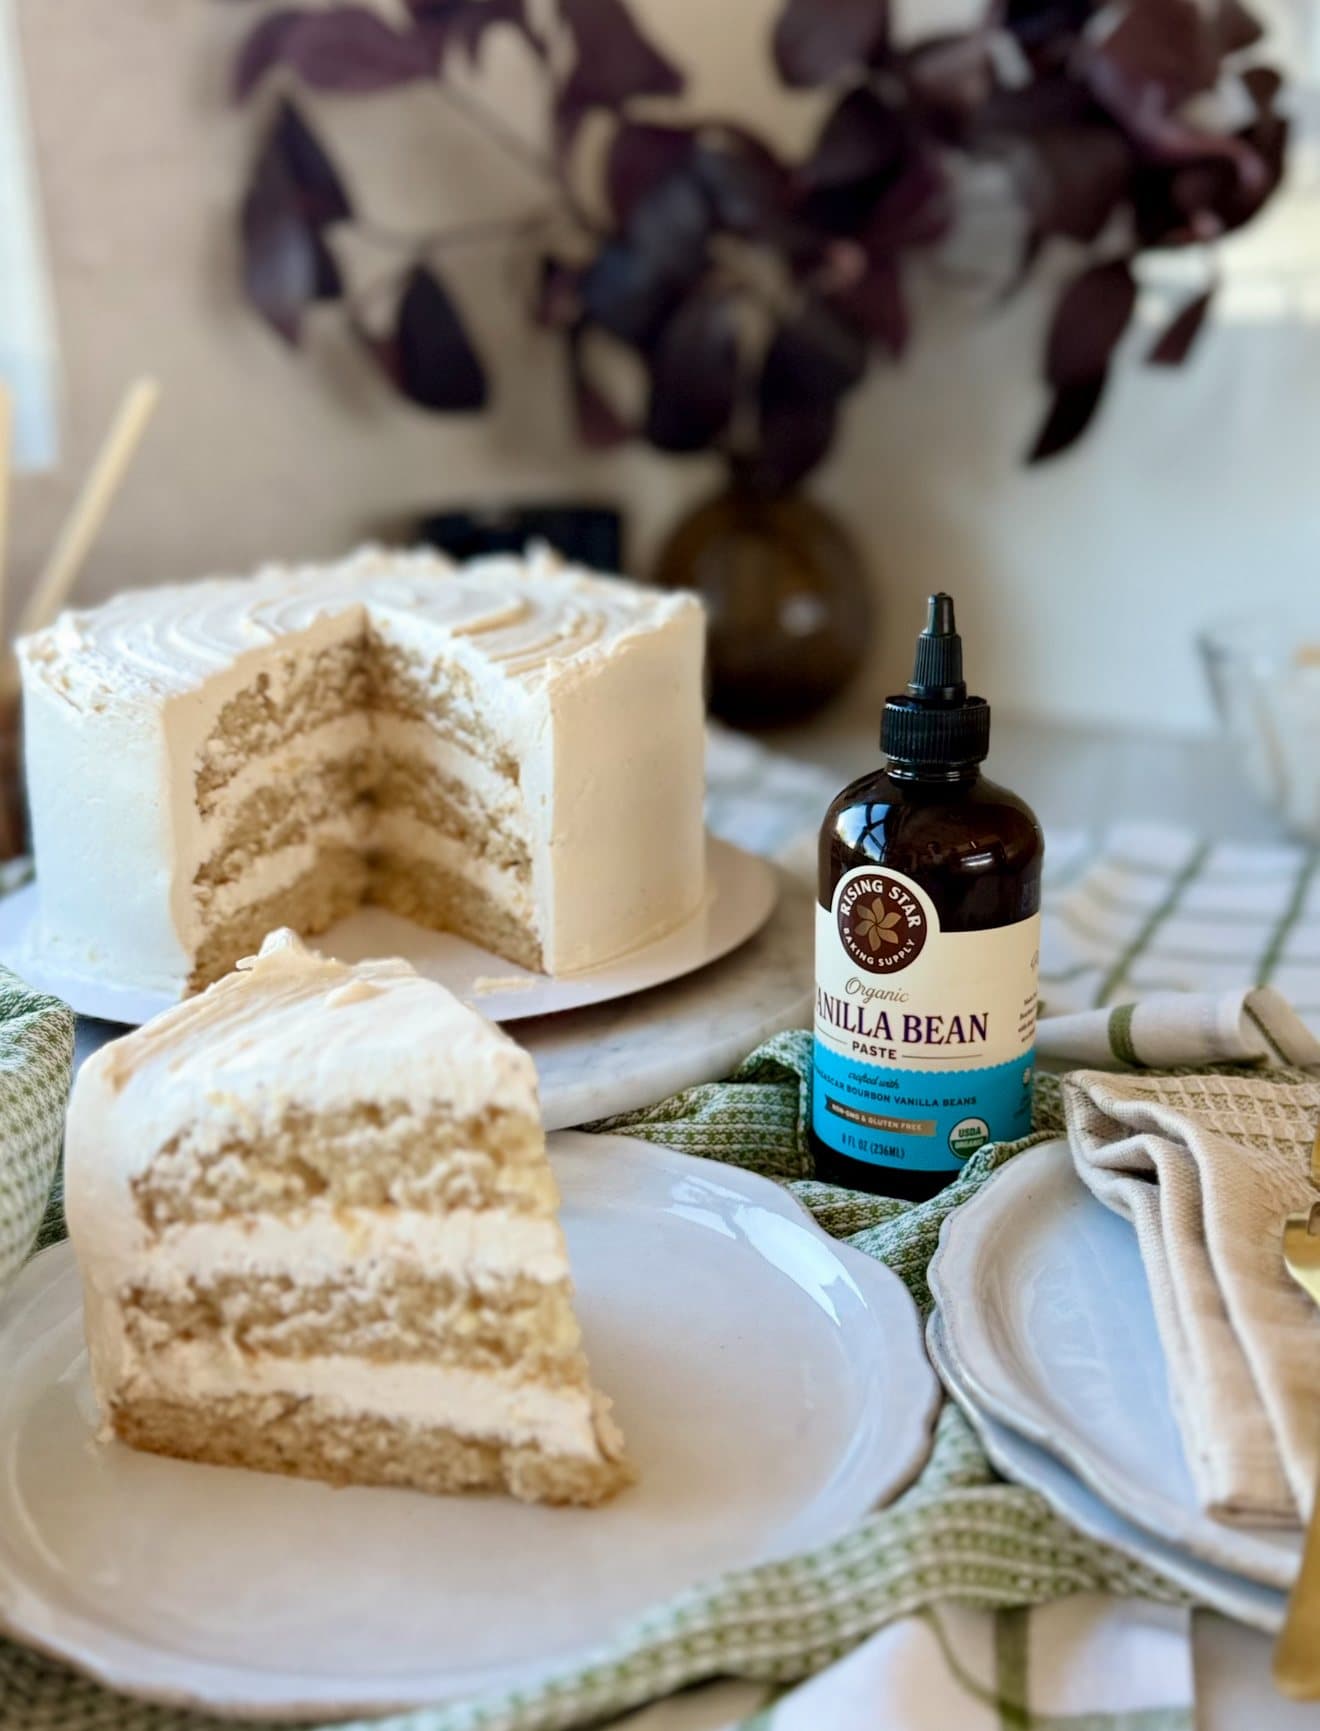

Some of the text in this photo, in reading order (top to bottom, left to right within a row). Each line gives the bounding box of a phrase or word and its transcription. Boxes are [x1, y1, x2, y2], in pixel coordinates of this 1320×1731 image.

[840, 879, 922, 929] RISING STAR
[843, 927, 916, 967] BAKING SUPPLY
[845, 976, 910, 1004] Organic
[902, 1012, 990, 1045] BEAN
[852, 1040, 897, 1060] PASTE
[879, 1076, 900, 1089] with
[846, 1085, 891, 1104] BOURBON
[894, 1095, 940, 1108] VANILLA
[943, 1096, 977, 1107] BEANS
[831, 1103, 923, 1131] NON-GMO & GLUTEN FREE
[958, 1126, 981, 1138] USDA
[848, 1135, 856, 1148] FL
[858, 1138, 868, 1151] OZ
[870, 1142, 906, 1160] (236ML)
